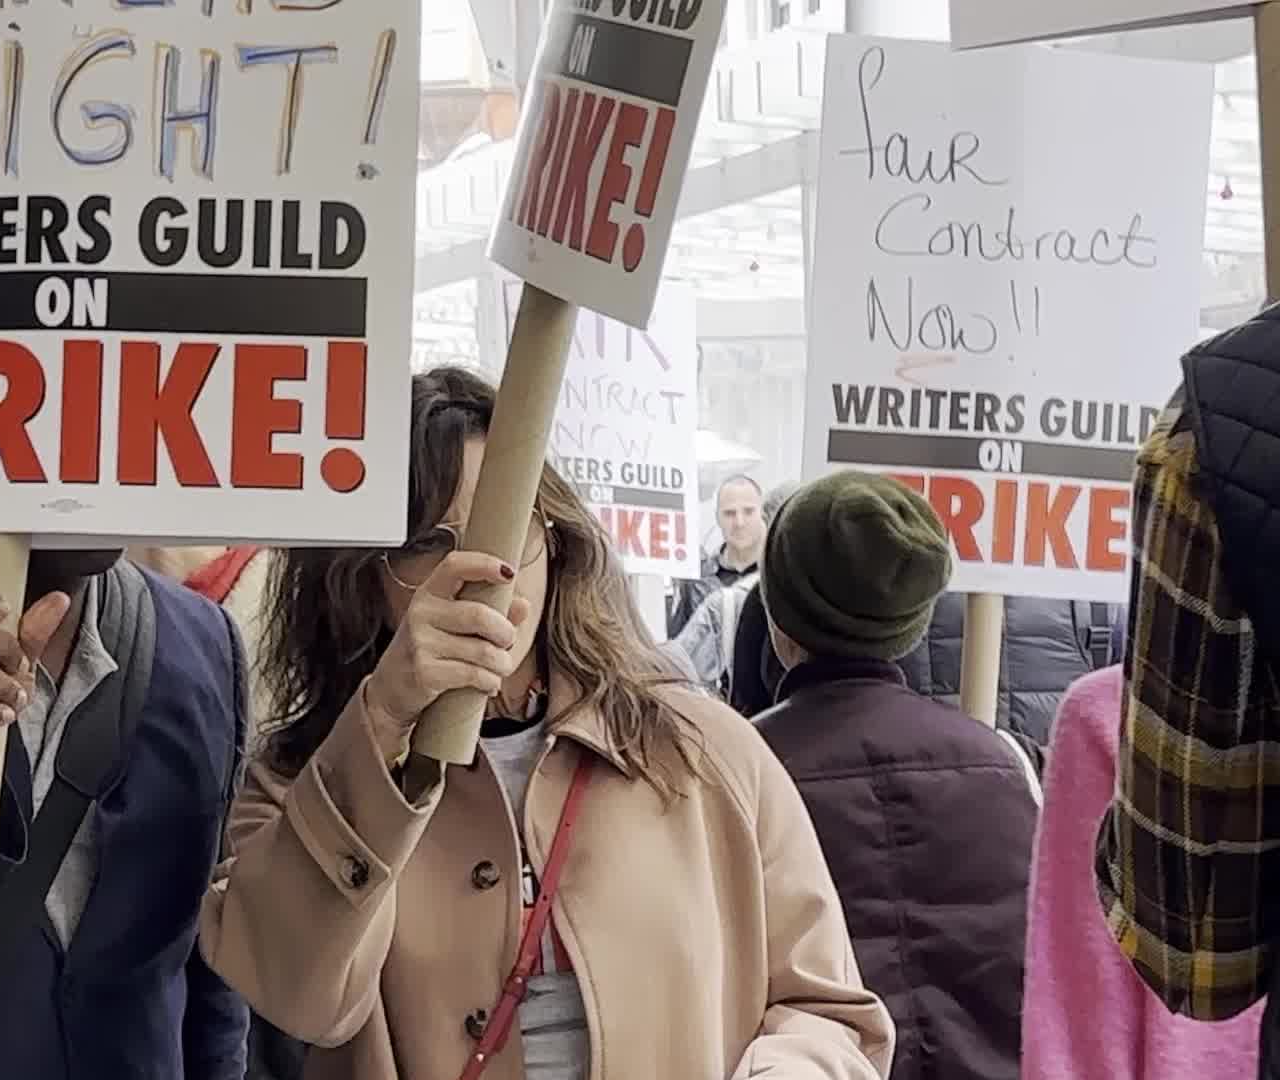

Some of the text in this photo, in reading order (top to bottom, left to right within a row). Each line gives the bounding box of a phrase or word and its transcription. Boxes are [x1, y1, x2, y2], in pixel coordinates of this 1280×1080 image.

[569, 24, 596, 76] ON
[517, 82, 676, 273] RIKE!
[137, 197, 367, 270] GUILD
[874, 193, 1157, 268] Contract
[34, 277, 109, 327] ON
[565, 374, 686, 424] NTRACT
[832, 383, 1025, 434] WRITERS
[556, 456, 684, 489] TERS GUILD
[978, 440, 1023, 474] ON
[600, 507, 687, 561] IKE!
[887, 473, 1132, 573] RIKE
